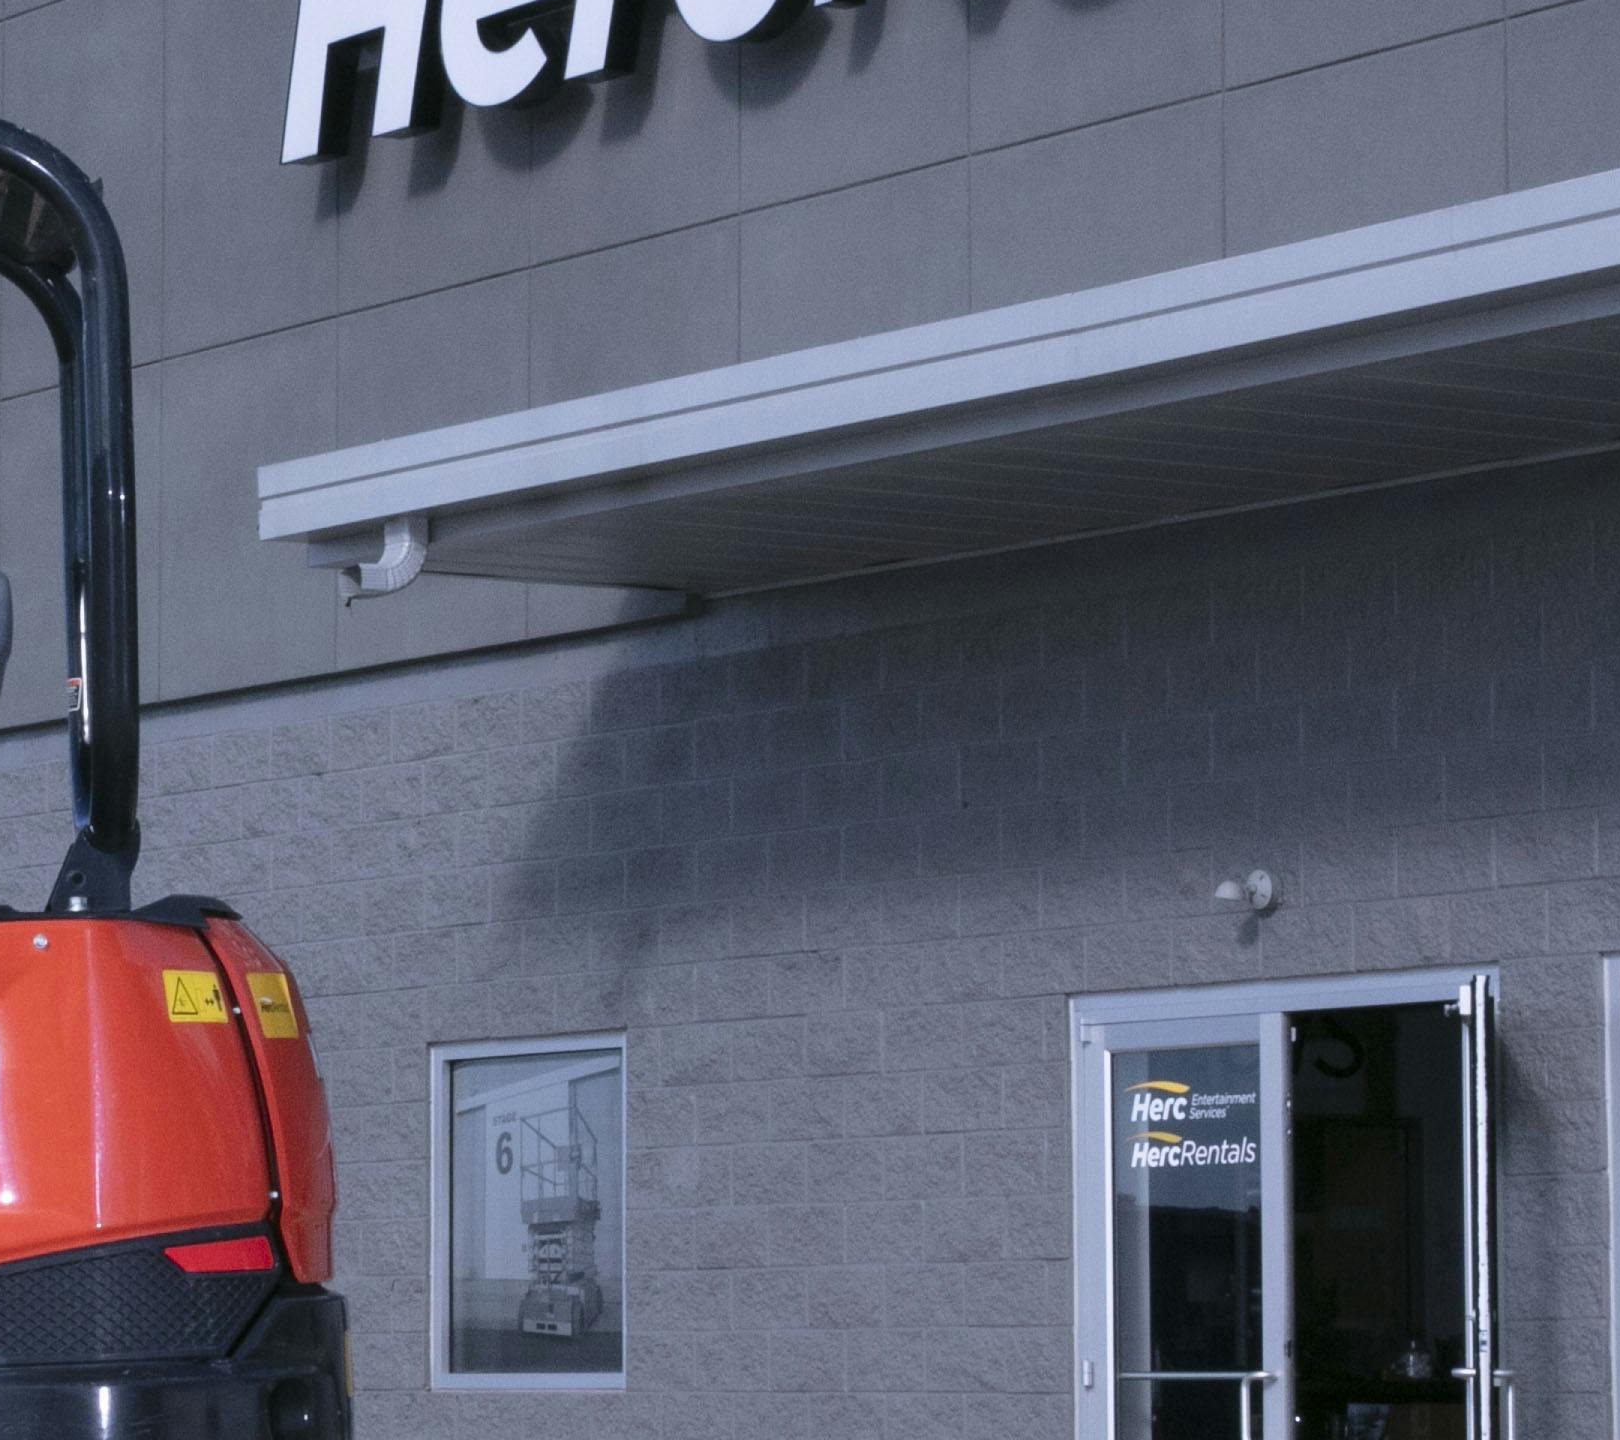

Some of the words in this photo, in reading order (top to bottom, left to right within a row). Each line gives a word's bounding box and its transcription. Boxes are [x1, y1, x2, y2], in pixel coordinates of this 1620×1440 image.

[1131, 1093, 1188, 1122] Herc
[1191, 1091, 1257, 1106] Entertainment
[1189, 1107, 1227, 1120] Services
[496, 1131, 513, 1175] 6
[1130, 1136, 1257, 1168] HercRentals
